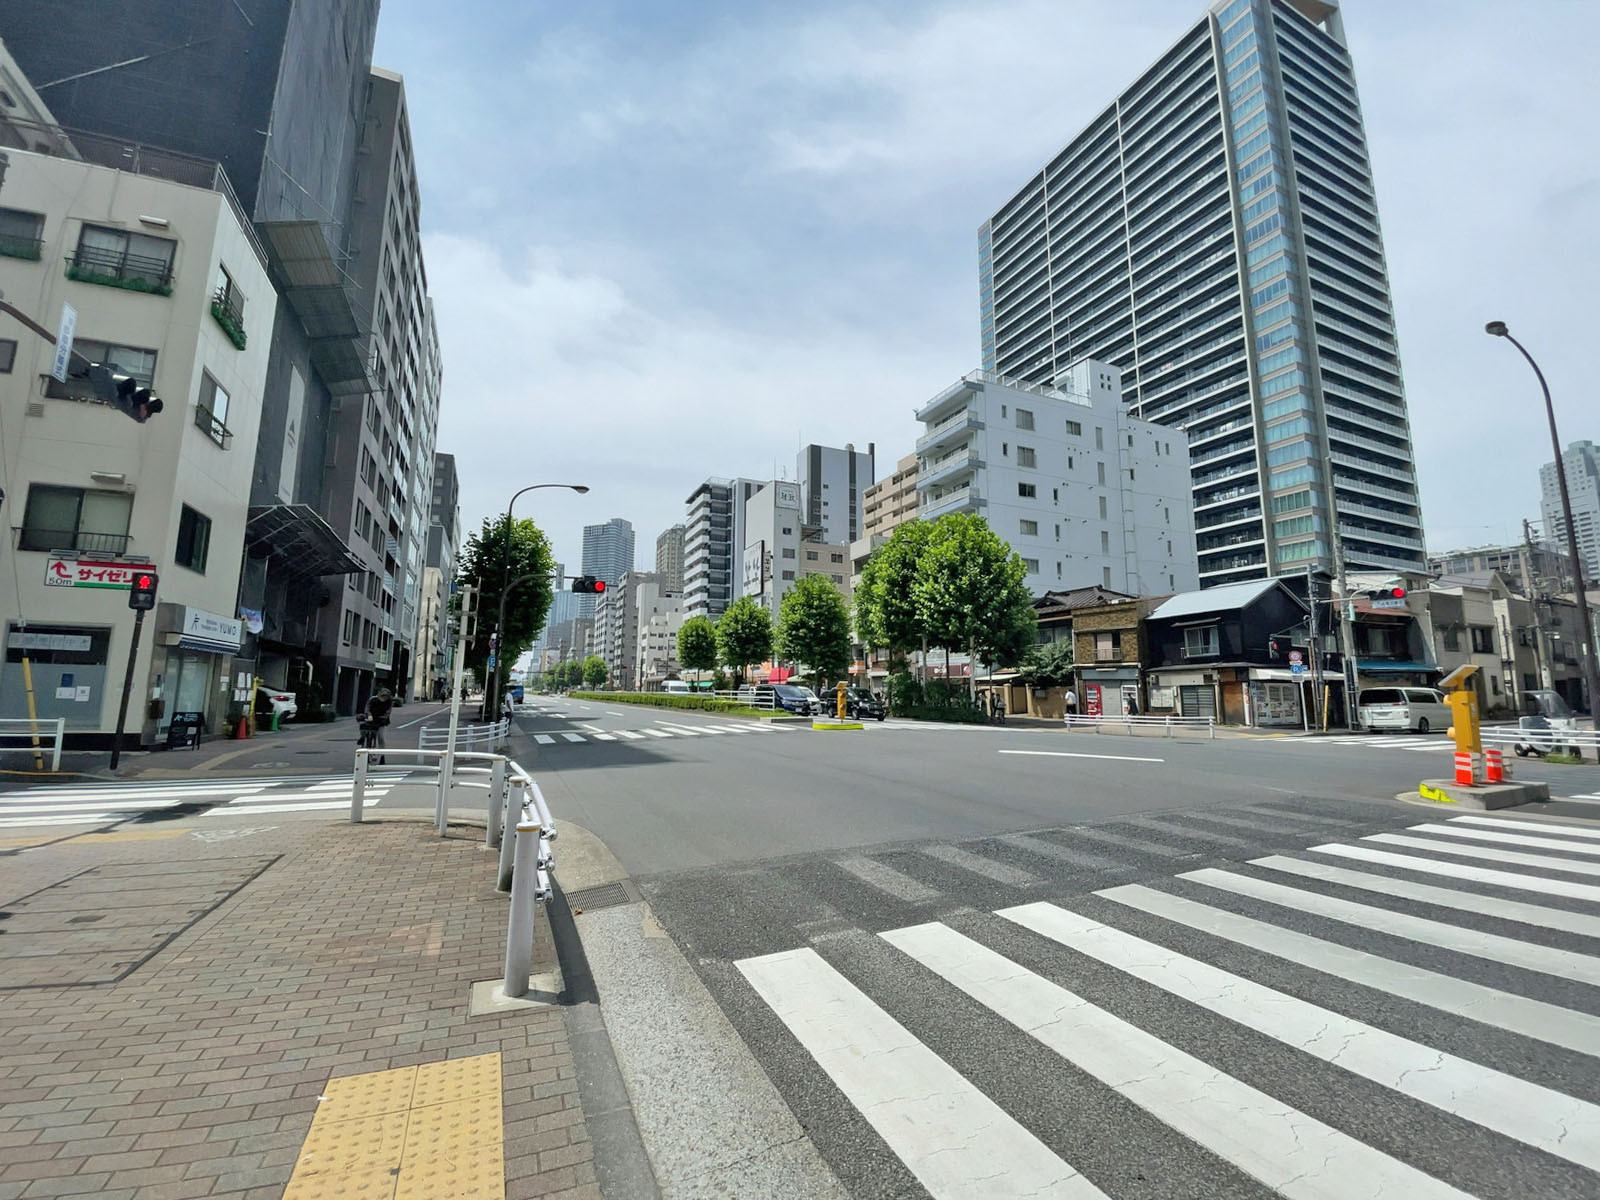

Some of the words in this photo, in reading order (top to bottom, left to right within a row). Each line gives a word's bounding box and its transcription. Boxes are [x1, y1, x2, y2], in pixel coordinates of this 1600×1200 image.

[49, 577, 72, 585] 50m
[78, 568, 134, 583] サイゼリ
[219, 622, 237, 636] YUMO
